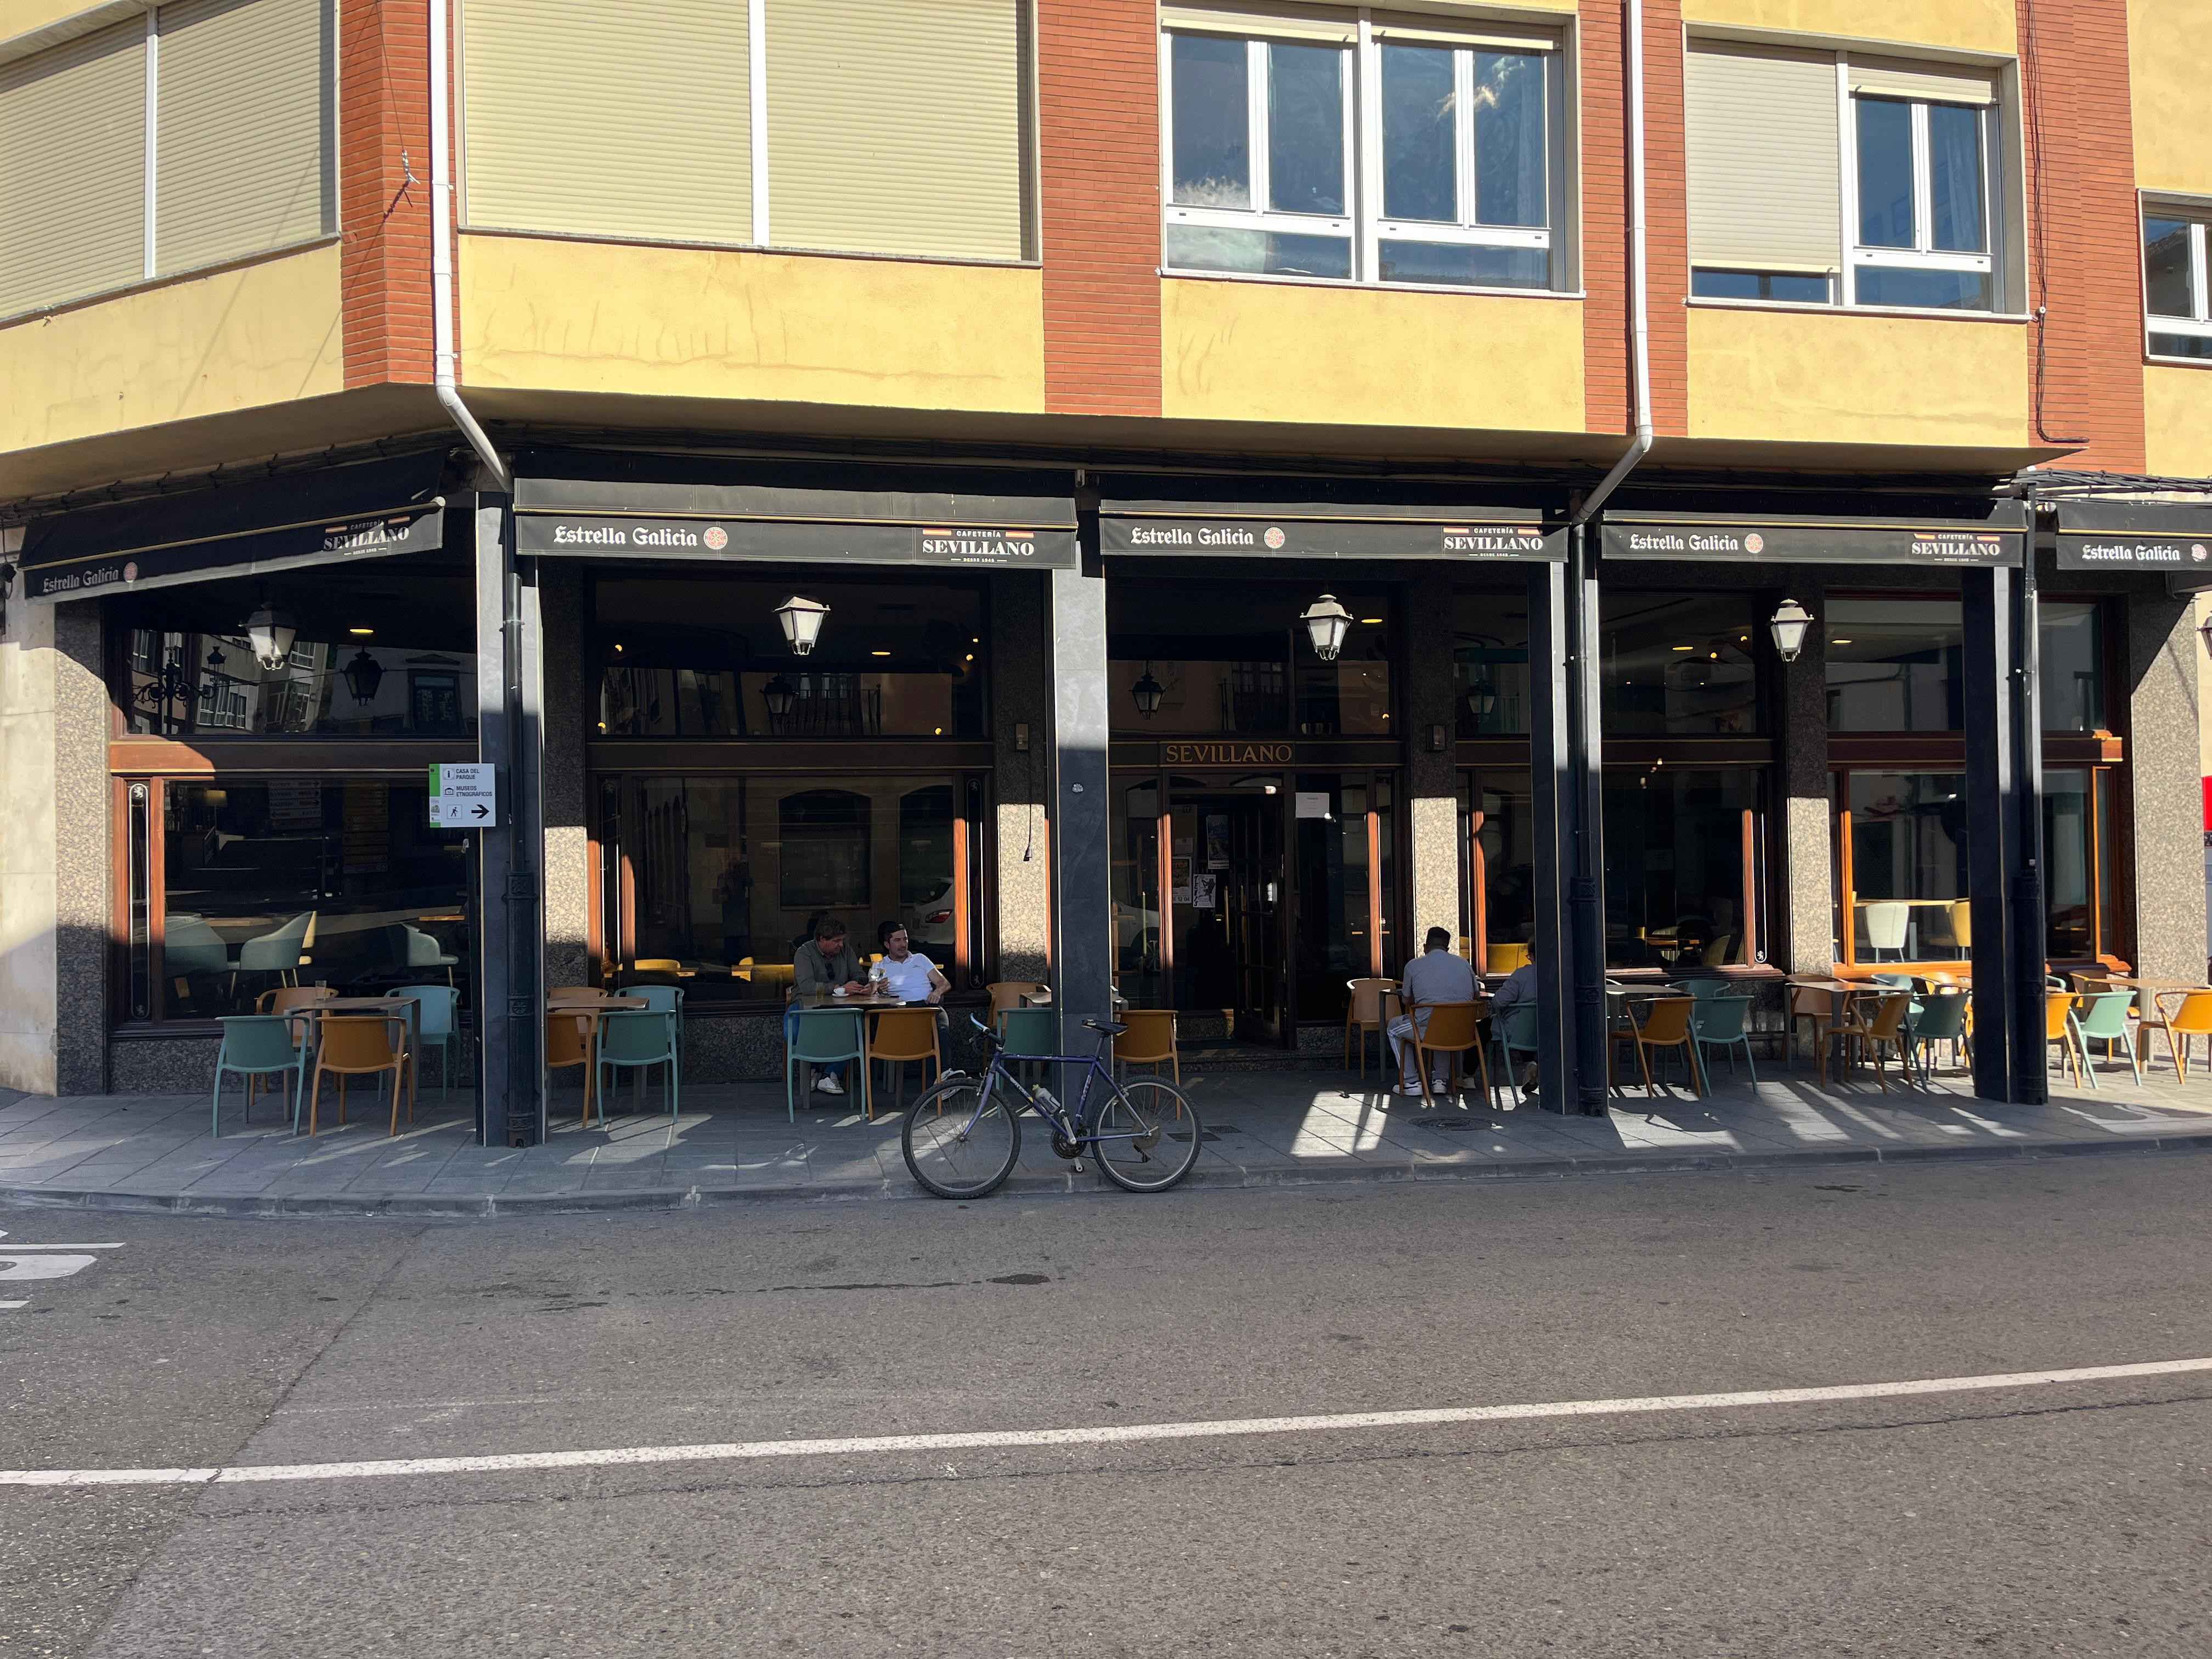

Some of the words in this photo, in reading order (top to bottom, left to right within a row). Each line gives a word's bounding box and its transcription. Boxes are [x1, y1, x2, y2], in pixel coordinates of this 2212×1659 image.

[351, 519, 384, 530] CAFETERÍA
[324, 527, 409, 550] SEVILLANO
[553, 525, 626, 544] Estrella
[632, 527, 698, 546] Galicia
[1130, 527, 1193, 544] Estrella
[1198, 528, 1254, 545] Galicia
[1444, 537, 1543, 550] SEVILLANO
[1629, 533, 1684, 550] Estrella
[1689, 534, 1739, 550] Galicia
[922, 539, 1035, 556] SEVILLANO
[1911, 543, 2000, 556] SEVILLANO
[2082, 544, 2132, 560] Estrella
[2135, 545, 2181, 561] Galicia
[43, 574, 80, 592] Estrella
[83, 567, 119, 586] Galicia
[1166, 745, 1293, 763] SEVILLANO
